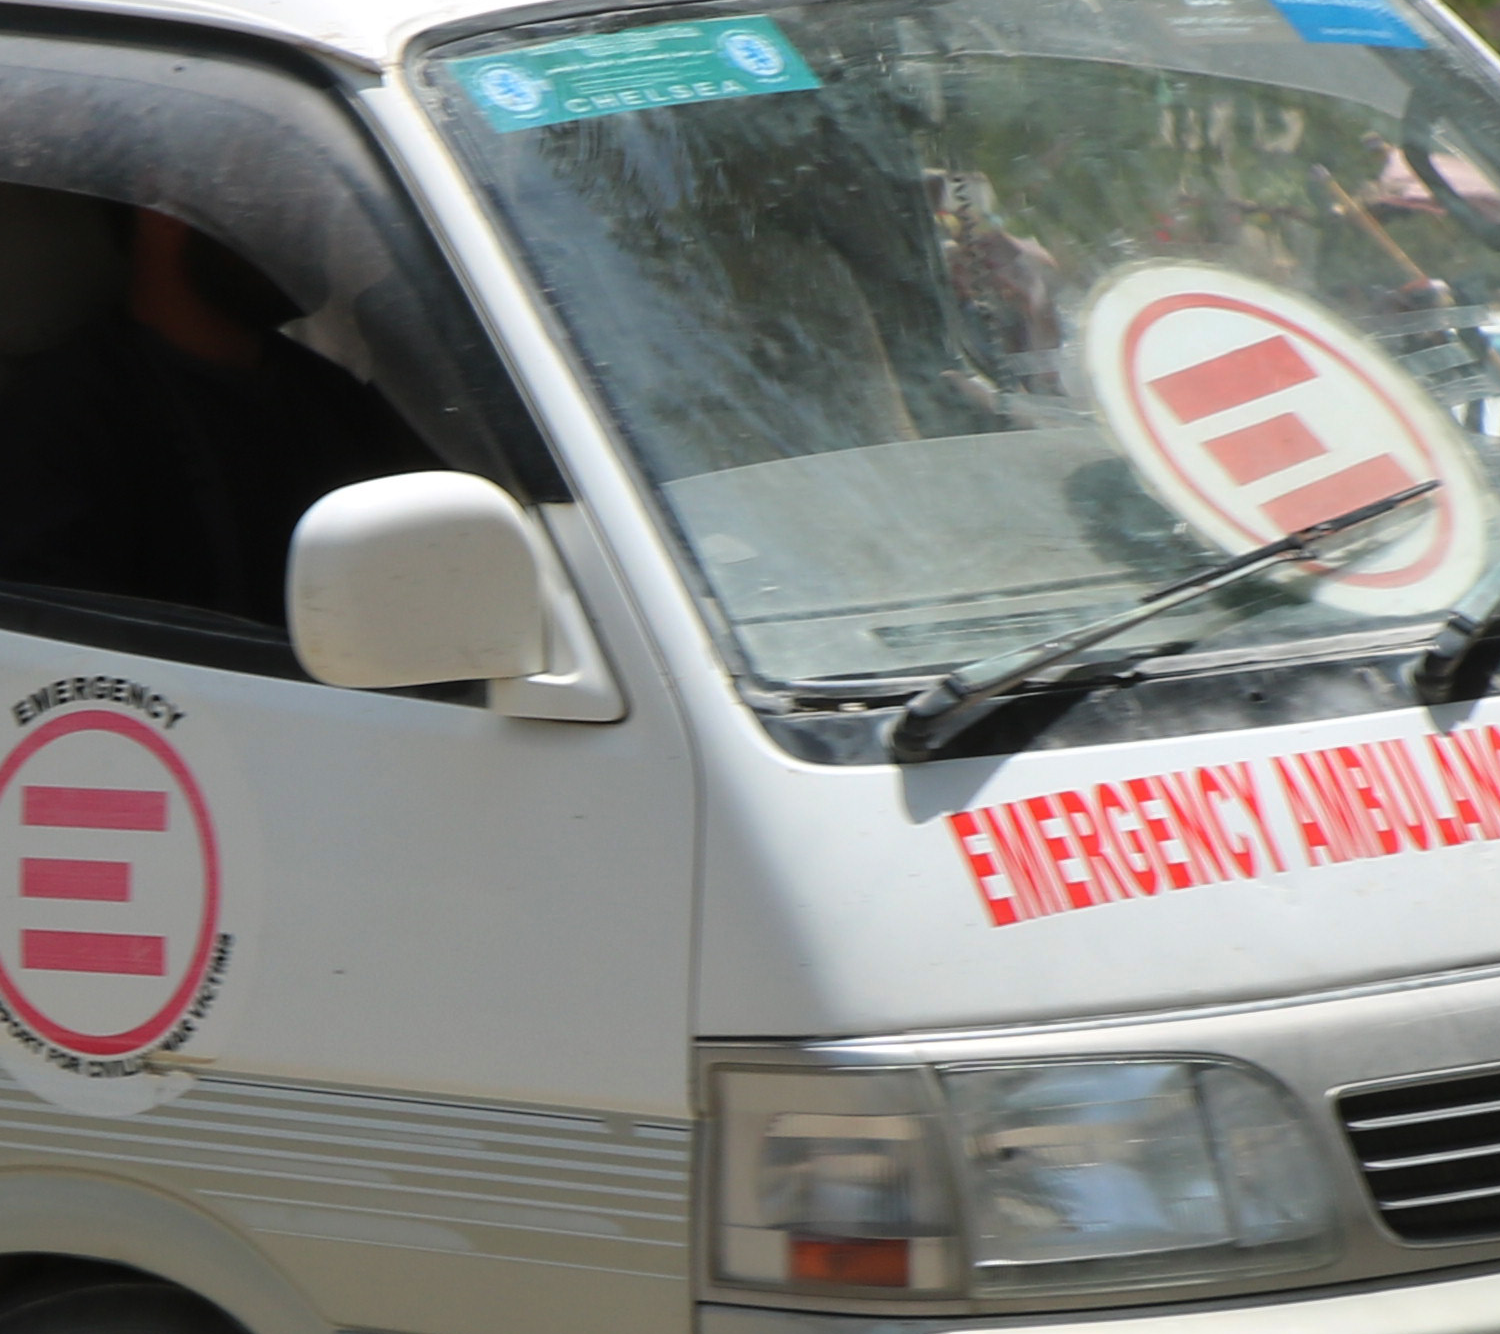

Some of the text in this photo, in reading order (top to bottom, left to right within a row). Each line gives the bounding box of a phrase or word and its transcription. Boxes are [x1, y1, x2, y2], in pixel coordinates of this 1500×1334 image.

[563, 78, 748, 114] CHELSEA
[11, 675, 187, 730] EMERGENCY
[943, 758, 1289, 929] EMERGENCY
